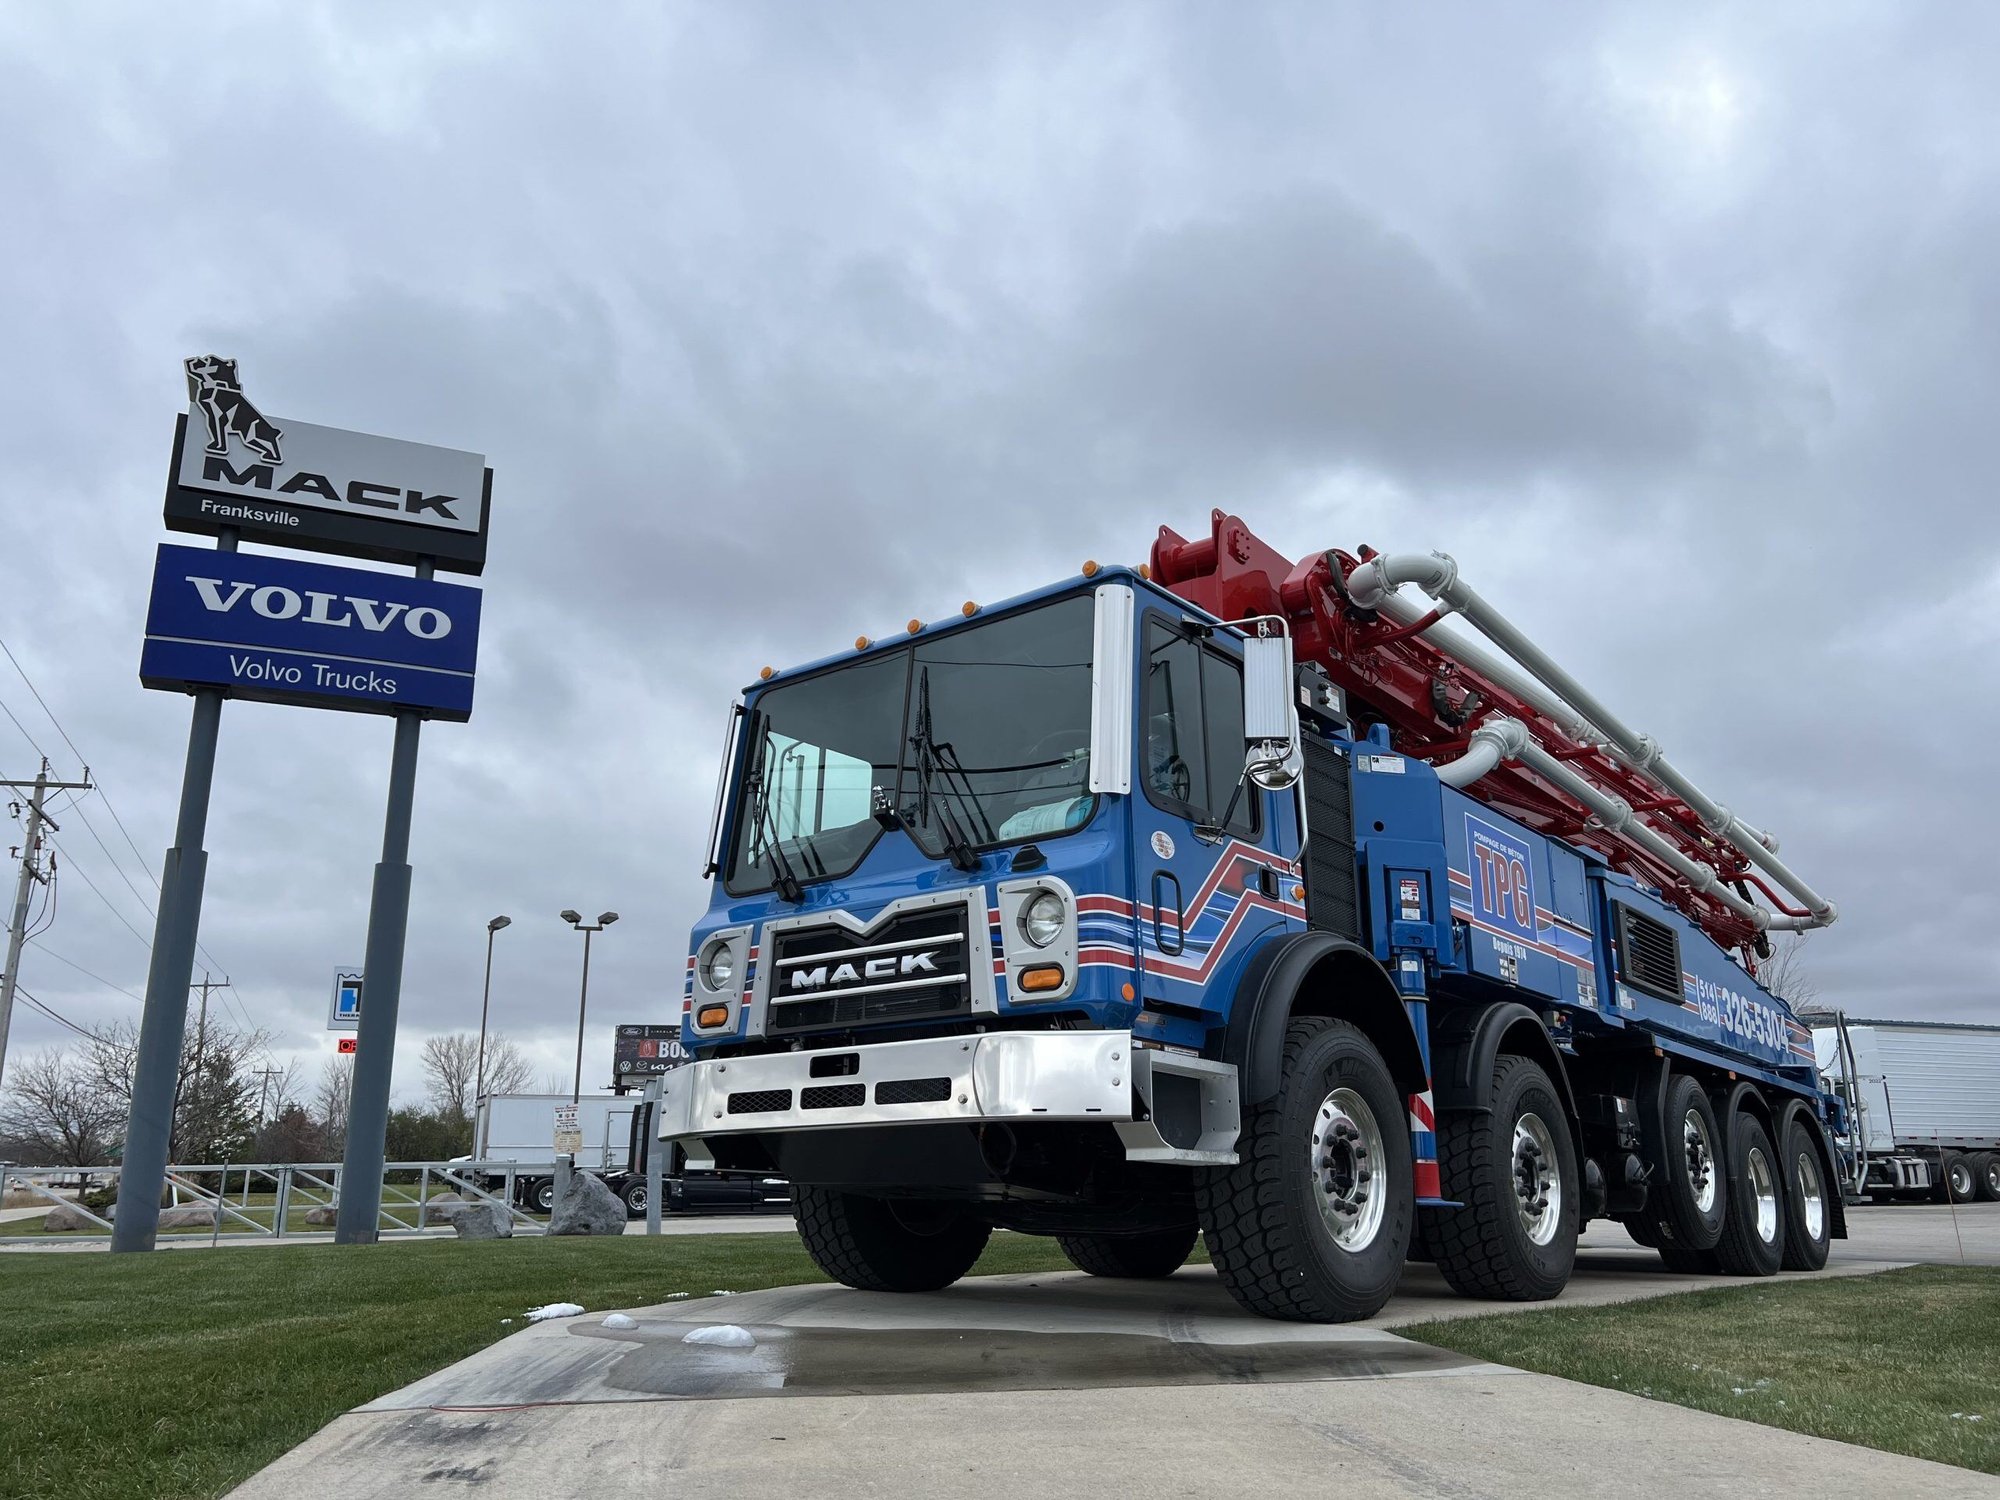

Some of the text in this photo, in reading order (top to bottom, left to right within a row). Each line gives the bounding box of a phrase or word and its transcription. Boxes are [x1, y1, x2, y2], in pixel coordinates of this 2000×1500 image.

[200, 499, 300, 527] Franksville
[202, 455, 460, 520] MACK
[185, 575, 452, 640] VOLVO
[229, 654, 397, 695] Volvo Trucks
[1474, 841, 1531, 929] TPG
[791, 951, 941, 989] MACK
[1722, 987, 1789, 1053] 326-5304
